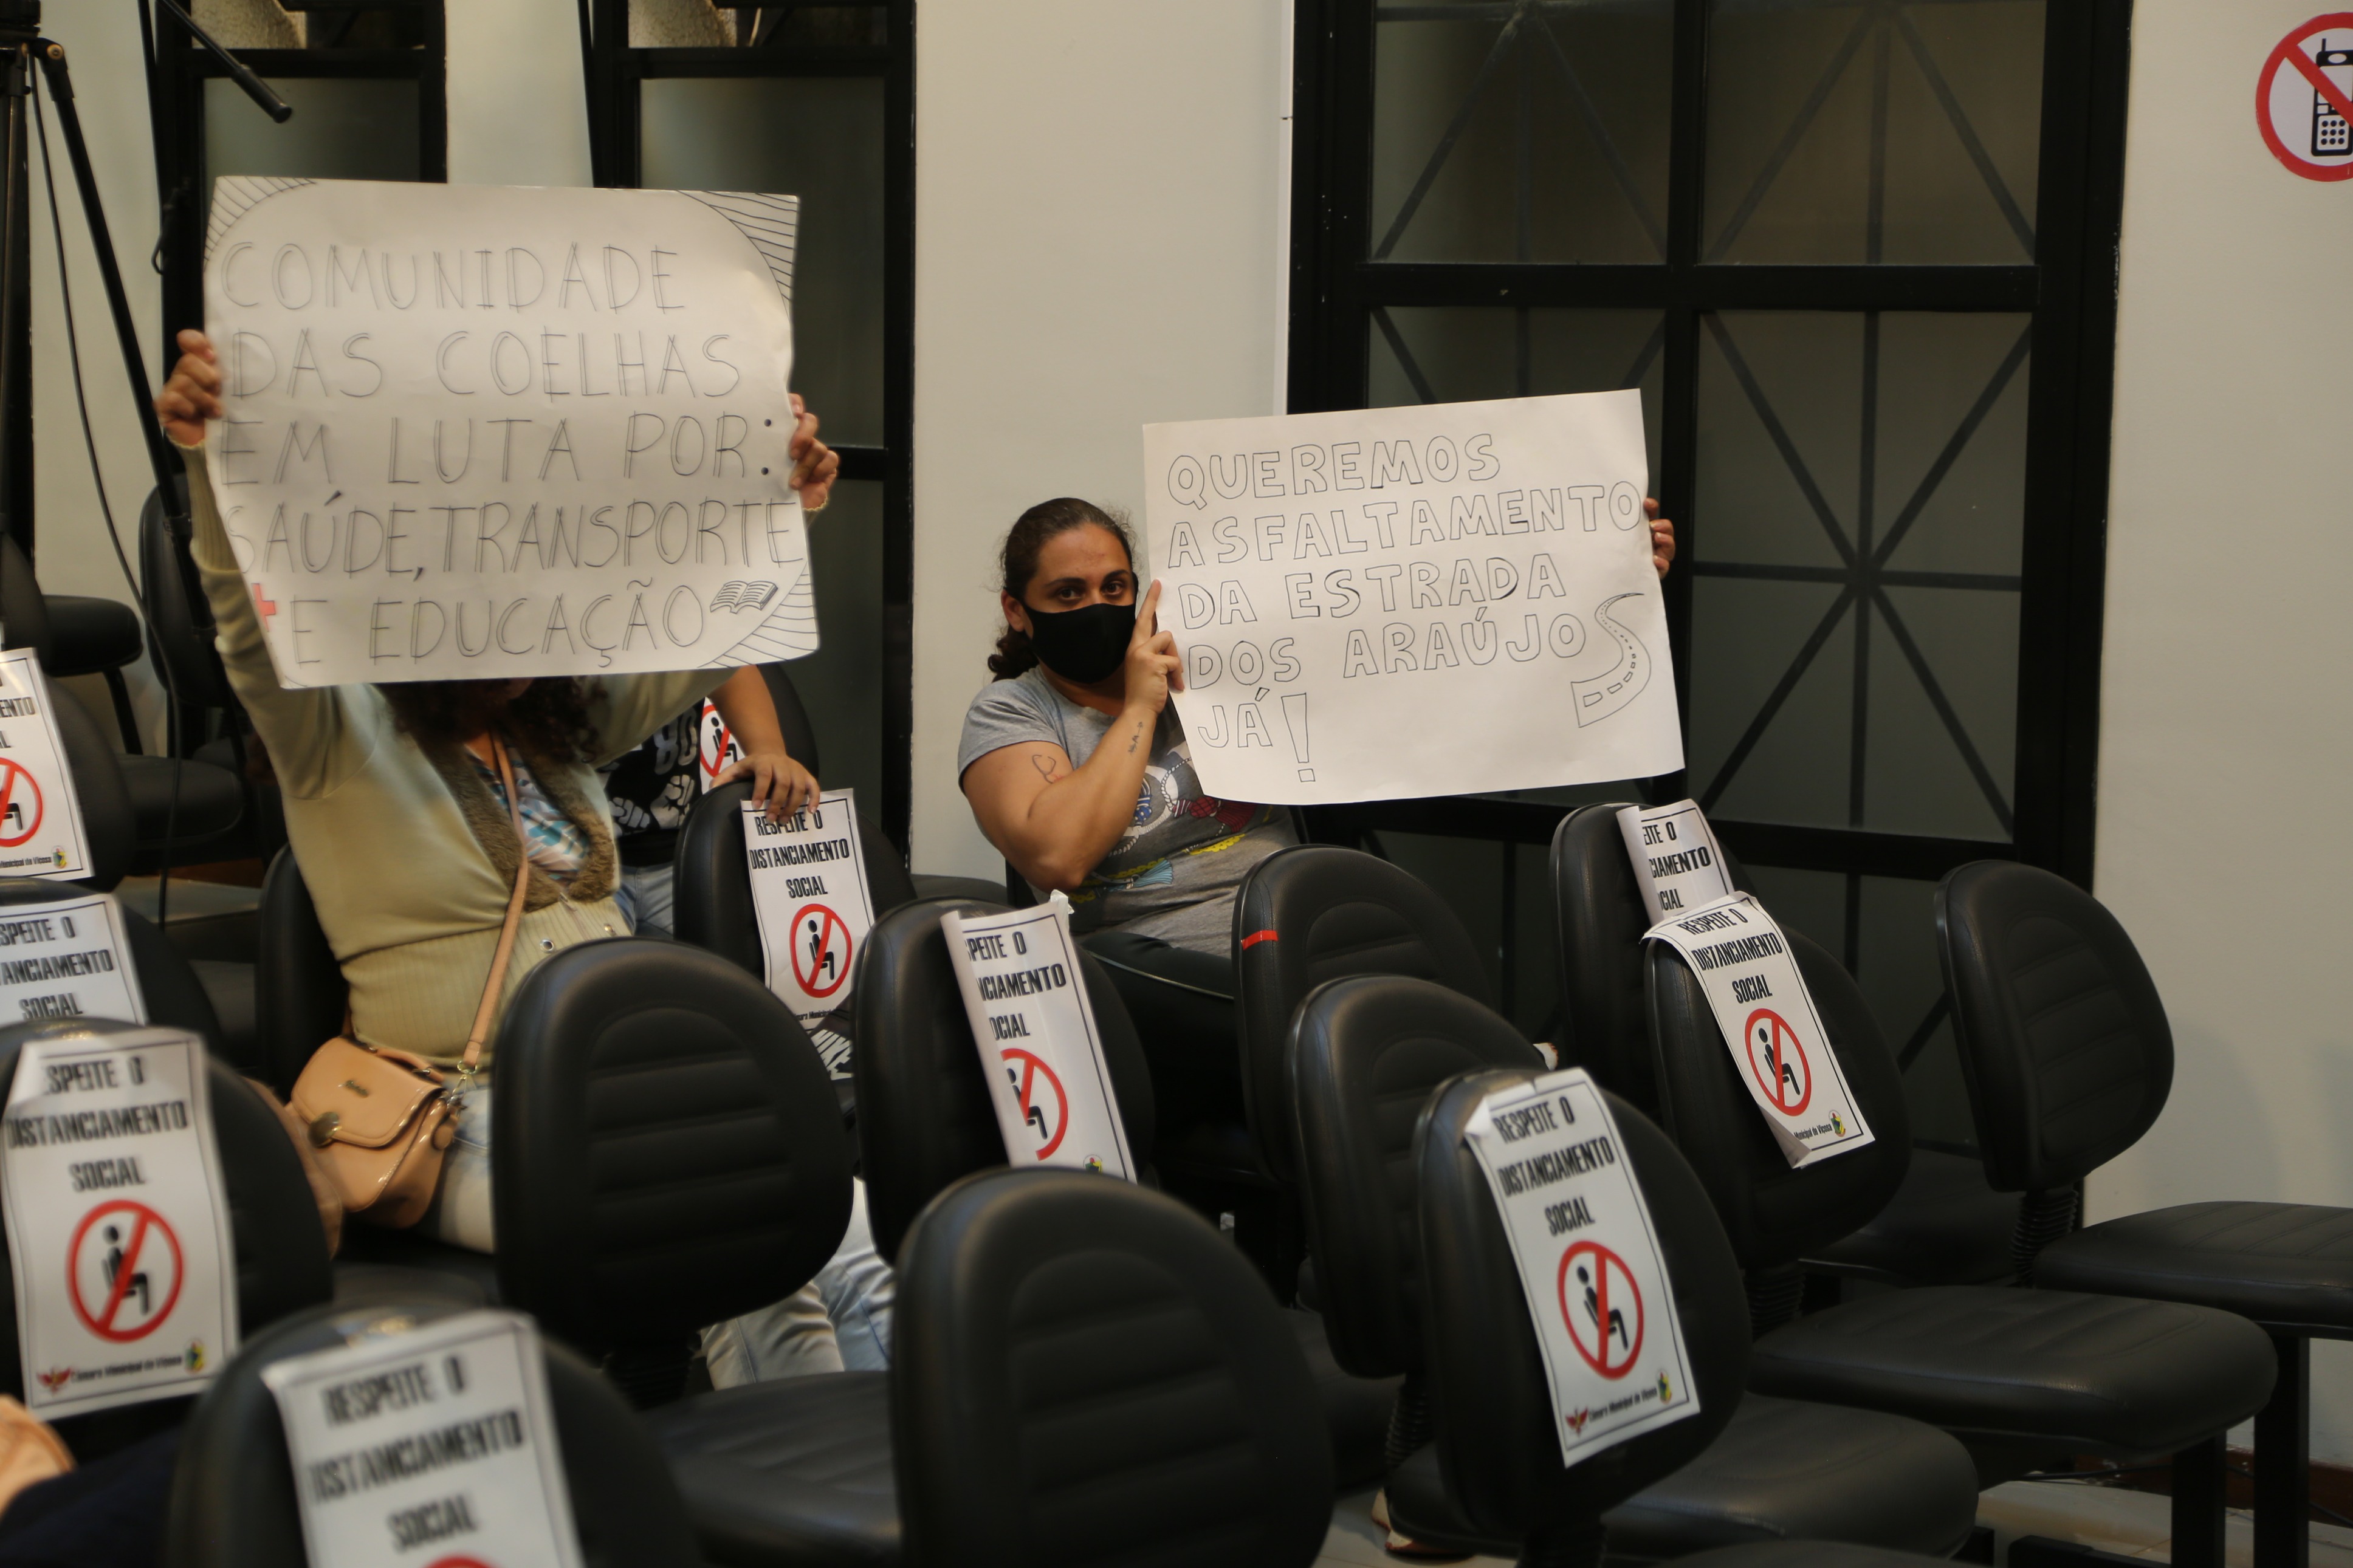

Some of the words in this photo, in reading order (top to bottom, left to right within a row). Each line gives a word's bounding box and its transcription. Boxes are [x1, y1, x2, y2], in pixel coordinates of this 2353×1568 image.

[221, 241, 685, 313] COMUNIDADE
[231, 327, 382, 398] DAS
[436, 326, 740, 402] COELHAS
[221, 419, 331, 485] EM
[388, 417, 580, 484] LUTA
[1168, 434, 1500, 510] QUEREMOS
[1168, 481, 1642, 568] ASFALTAMENTO
[1178, 580, 1257, 629] DA
[1285, 554, 1565, 620] ESTRADA
[290, 600, 327, 664] E
[369, 577, 703, 667] EDUCAÇÃO
[1189, 637, 1300, 690] DOS
[812, 810, 823, 829] O
[1666, 821, 1677, 841] O
[749, 838, 850, 870] DISTANCIAMENTO
[786, 875, 828, 899] SOCIAL
[1657, 888, 1684, 911] CIAL
[61, 916, 76, 939] O
[1012, 931, 1027, 956] O
[1677, 910, 1737, 935] RESPEITE
[1730, 909, 1748, 923] O
[1691, 933, 1782, 971] DISTANCIAMENTO
[18, 993, 83, 1019] SOCIAL
[1732, 974, 1772, 1004] SOCIAL
[5, 1101, 188, 1149] DISTANCIAMENTO
[1492, 1101, 1558, 1144] RESPEITE
[1559, 1097, 1575, 1124] O
[70, 1159, 145, 1192] SOCIAL
[1497, 1136, 1615, 1197] DISTANCIAMENTO
[1544, 1196, 1595, 1237] SOCIAL
[323, 1364, 435, 1425] RESPEITE
[389, 1493, 476, 1553] SOCIAL
